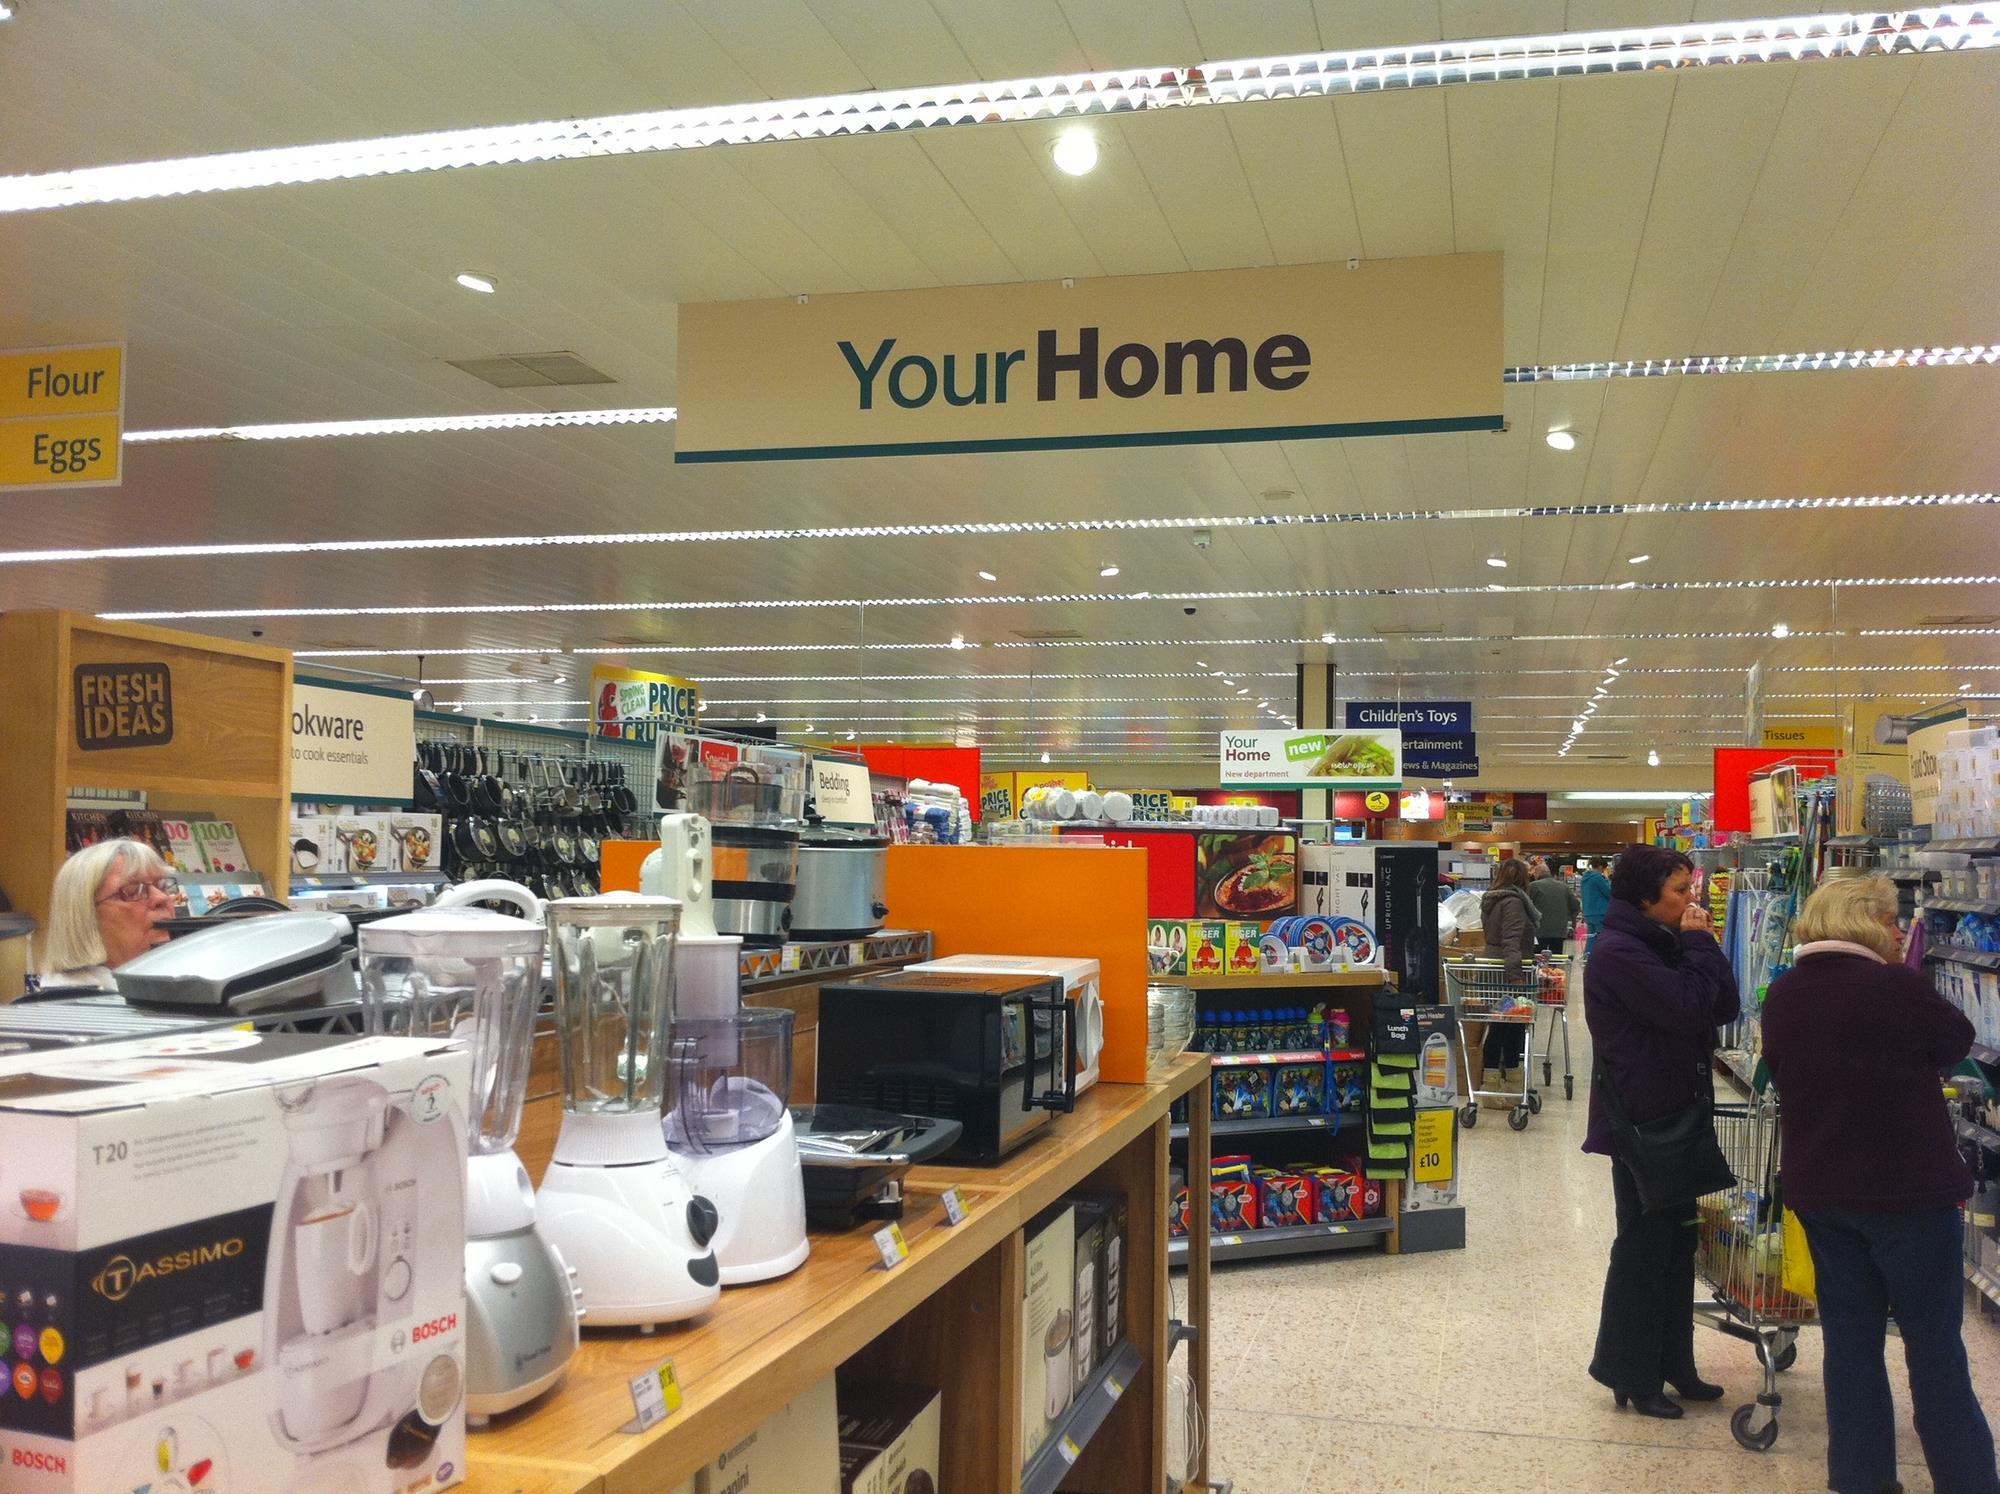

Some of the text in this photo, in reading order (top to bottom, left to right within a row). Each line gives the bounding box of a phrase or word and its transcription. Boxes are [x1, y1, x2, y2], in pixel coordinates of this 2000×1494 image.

[28, 364, 104, 399] Flour
[34, 433, 101, 474] Eggs
[81, 672, 165, 706] FRESH
[619, 683, 645, 700] SPRING
[621, 697, 647, 715] CLEAN
[649, 682, 696, 718] PRICE
[84, 702, 167, 739] IDEAS
[291, 703, 364, 741] okware
[1359, 708, 1458, 726] Children's Toys
[1225, 735, 1258, 748] Your
[1763, 729, 1805, 741] Tissues
[303, 747, 325, 761] cook
[327, 751, 368, 765] essentials
[1225, 748, 1271, 762] Home
[1288, 739, 1323, 757] new
[1225, 769, 1289, 780] New department
[1431, 761, 1478, 773] Magazines
[819, 771, 850, 797] Bedding
[981, 788, 1009, 811] PRICE
[1384, 890, 1392, 930] UPRIGHT
[1192, 929, 1220, 938] TIGER
[1231, 929, 1257, 938] TIGER
[1387, 1024, 1408, 1032] Lunch
[1391, 1032, 1406, 1040] Bag
[1419, 1152, 1440, 1168] £10
[97, 1237, 245, 1298] TASSIMO
[411, 1313, 457, 1344] BOSCH
[12, 1449, 66, 1474] BOSCH
